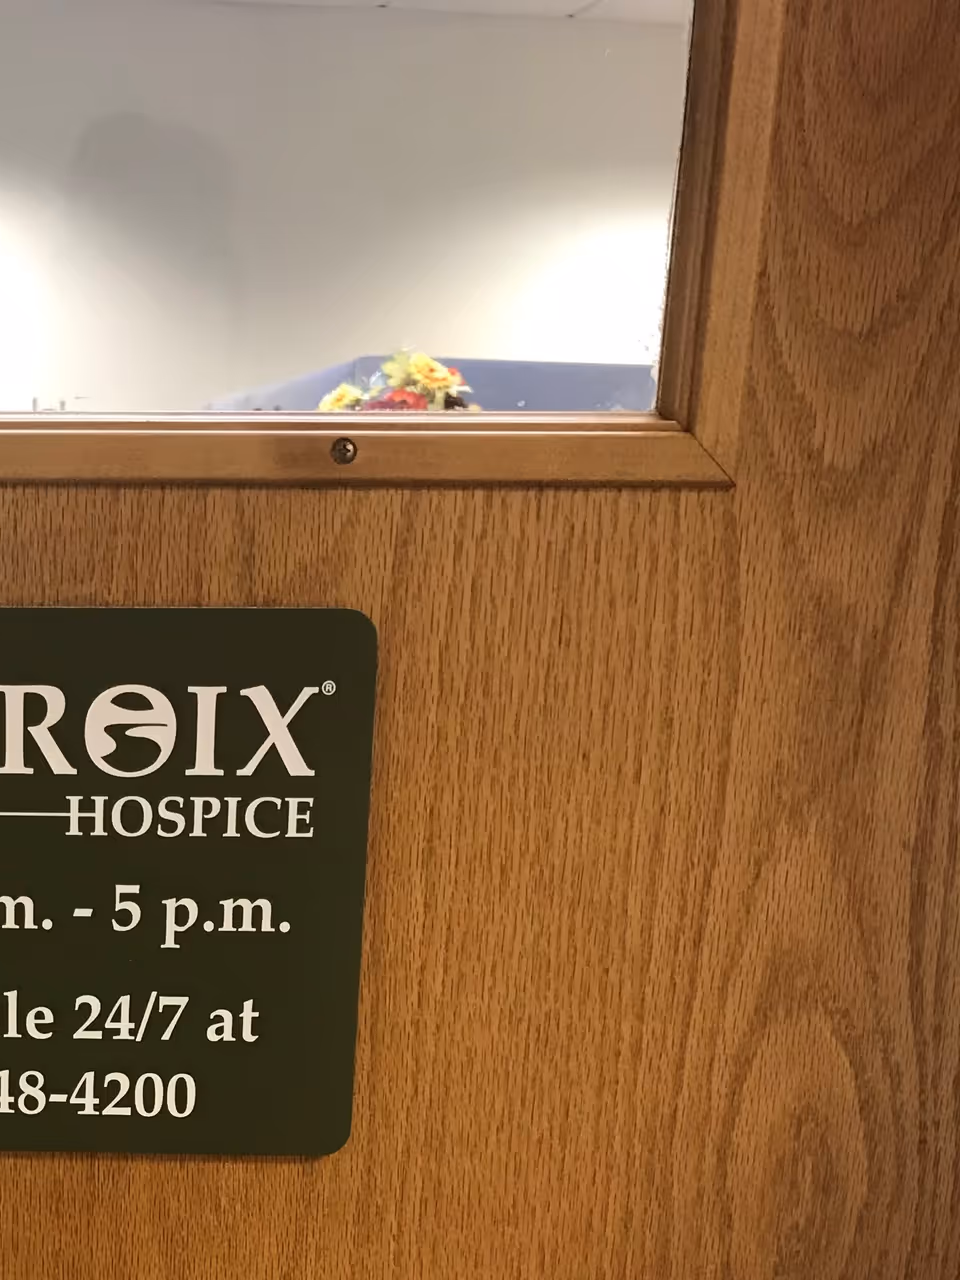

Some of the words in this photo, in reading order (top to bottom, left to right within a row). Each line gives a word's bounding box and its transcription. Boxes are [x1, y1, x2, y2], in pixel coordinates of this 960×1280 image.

[65, 795, 315, 839] HOSPICE
[111, 884, 142, 932] 5
[160, 897, 291, 949] p.m.
[72, 990, 190, 1042] 24/7
[206, 998, 260, 1043] at
